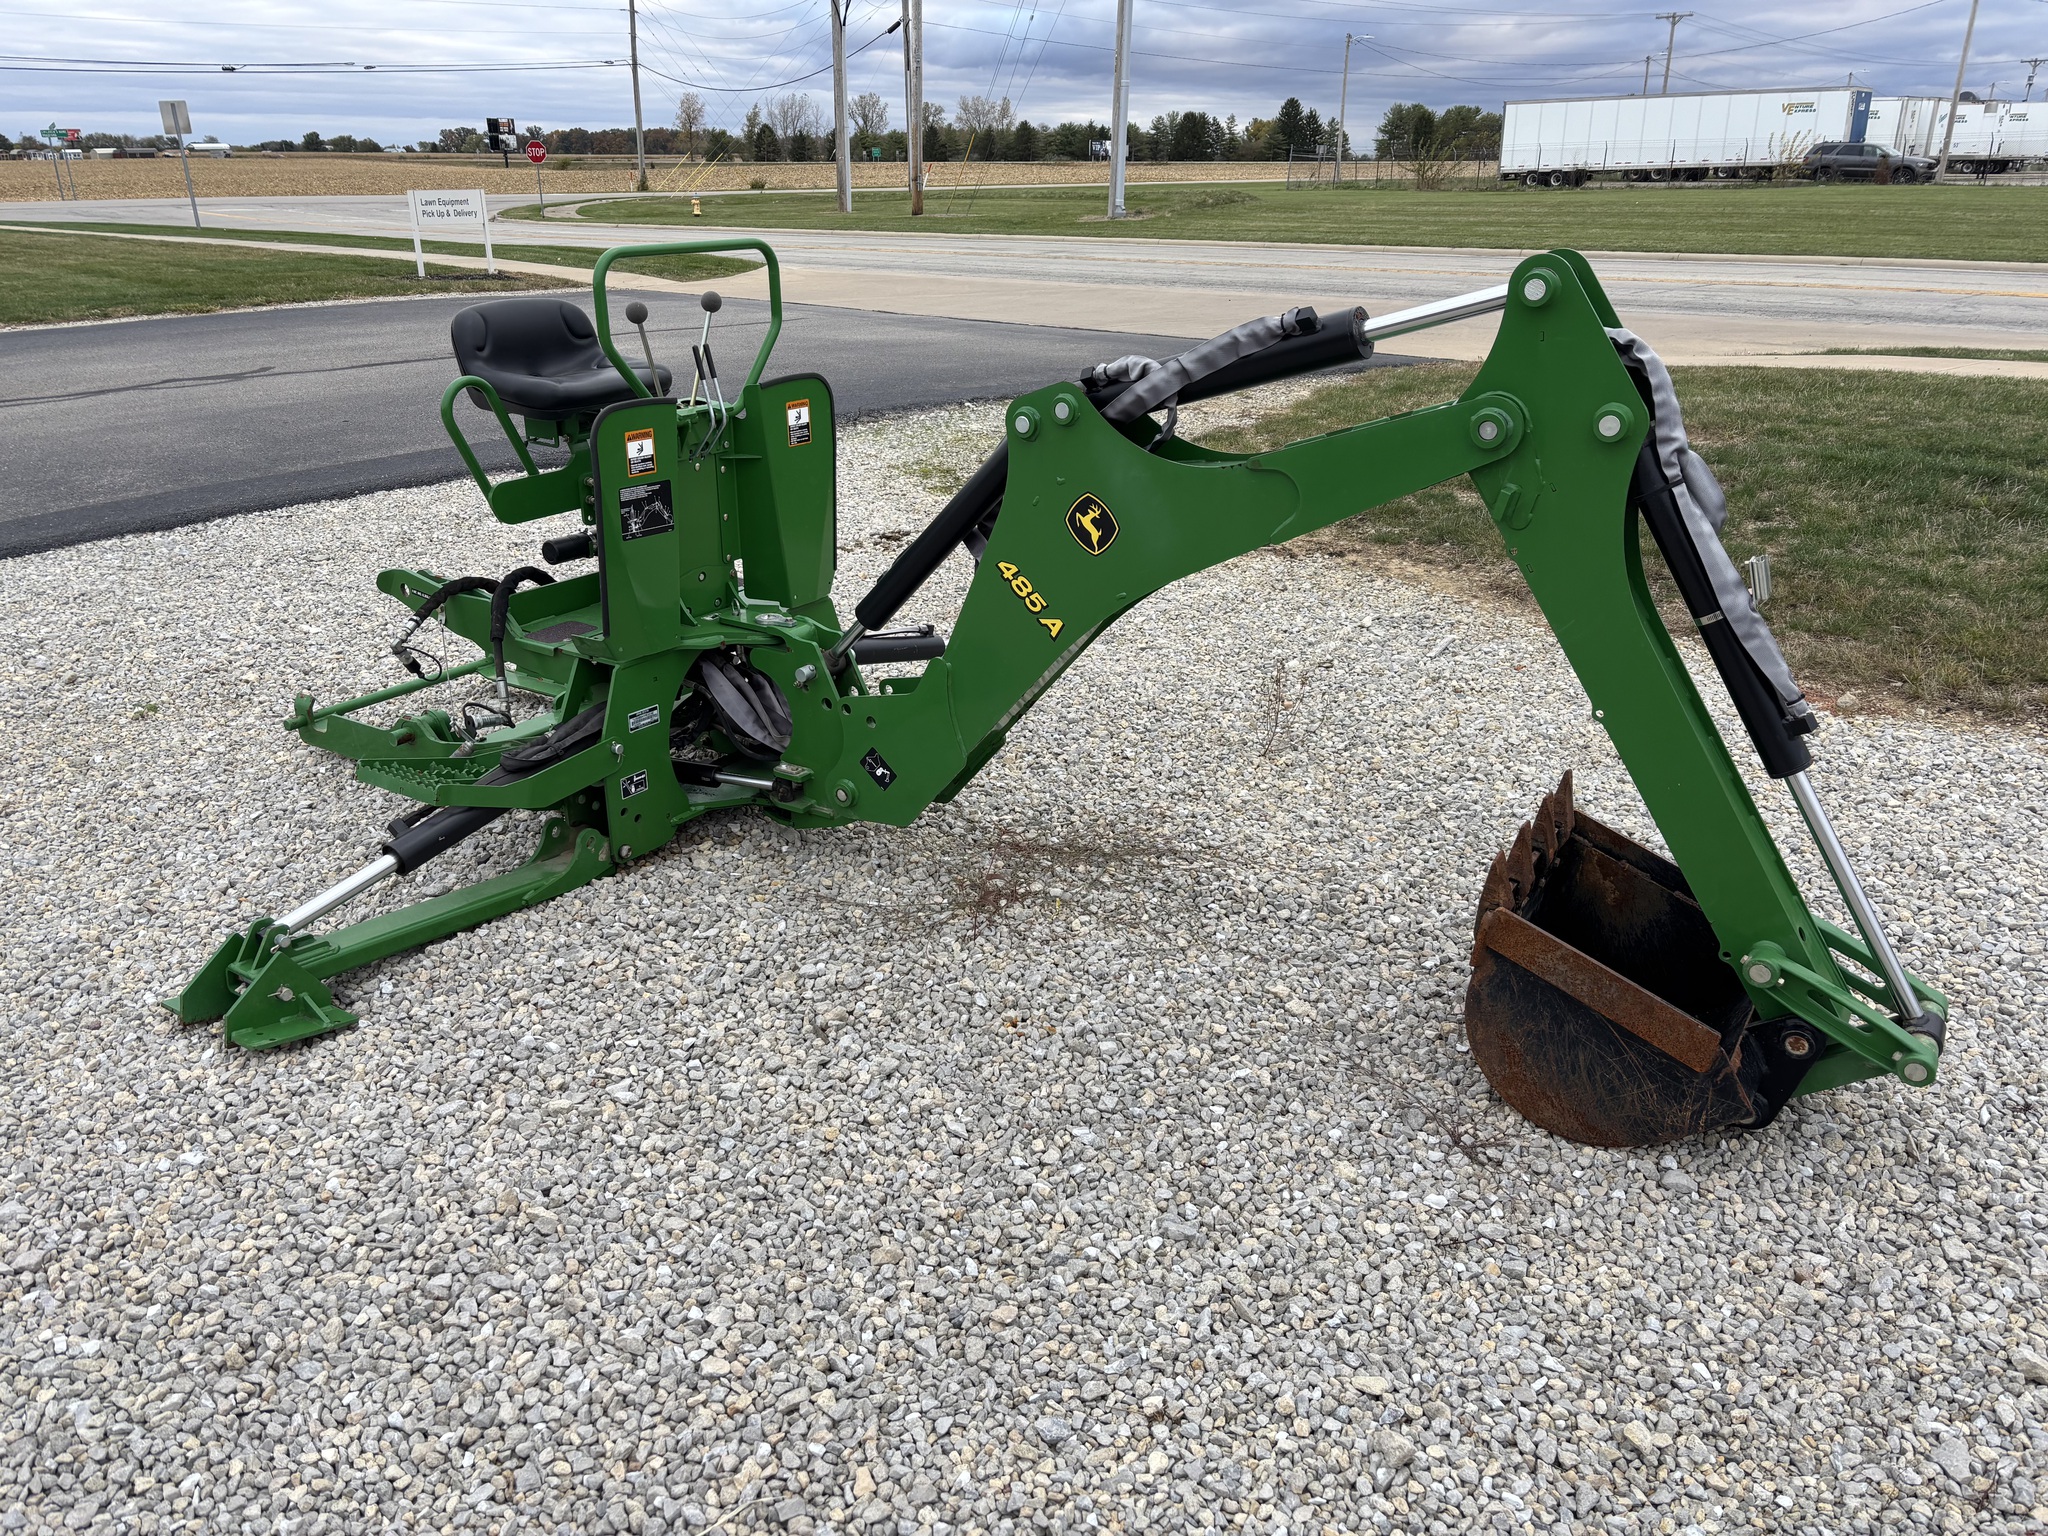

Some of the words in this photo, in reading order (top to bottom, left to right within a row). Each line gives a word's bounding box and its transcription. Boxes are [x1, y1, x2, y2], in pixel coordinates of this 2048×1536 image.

[527, 147, 545, 157] STOP
[420, 198, 437, 207] Lawn
[437, 197, 470, 208] Equipment
[422, 209, 436, 218] Pick
[436, 209, 446, 220] Up
[446, 209, 451, 218] &
[453, 208, 478, 219] Delivery
[630, 430, 652, 440] WARNING
